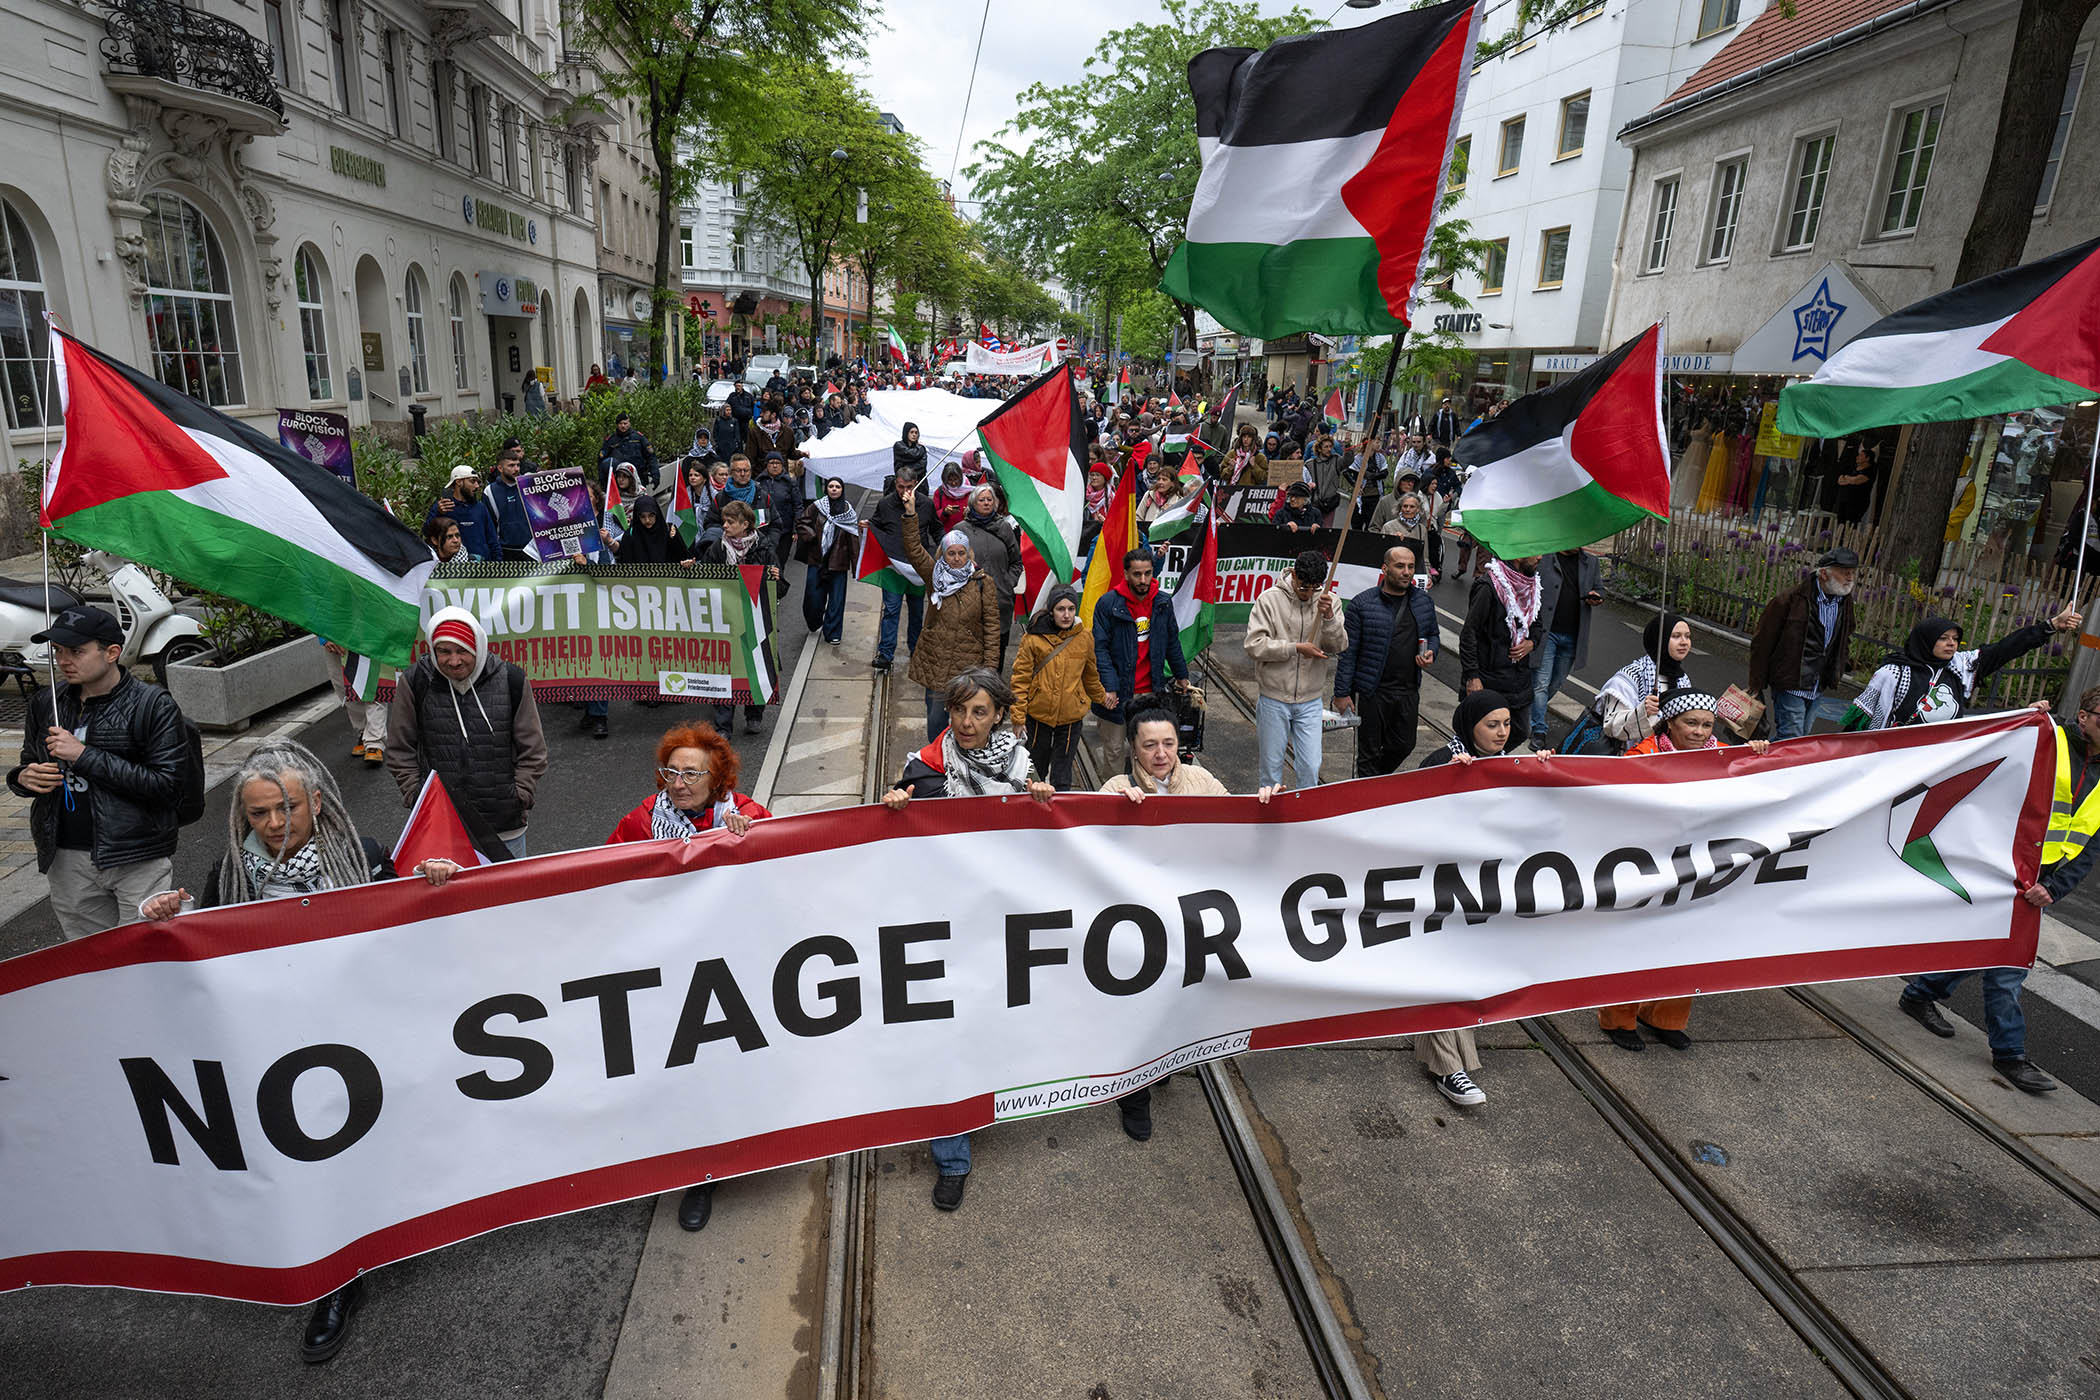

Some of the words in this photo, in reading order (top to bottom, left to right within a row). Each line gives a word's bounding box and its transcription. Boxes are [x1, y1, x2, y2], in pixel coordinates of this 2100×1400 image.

[330, 145, 386, 187] BIERGARTEN
[1434, 312, 1482, 333] STANYS
[1803, 307, 1831, 334] STERN
[1546, 358, 1579, 370] BRAUT
[1663, 355, 1713, 371] DMODE
[281, 418, 345, 437] EUROVISION
[295, 412, 329, 427] BLOCK
[522, 477, 583, 496] EUROVISION
[533, 471, 567, 486] BLOCK
[535, 527, 557, 538] DON'T
[557, 520, 596, 533] CELEBRATE
[549, 528, 585, 541] GENOCIDE
[1233, 558, 1265, 571] CAN'T
[420, 583, 586, 636] OYKOTT
[597, 583, 731, 634] ISRAEL
[489, 635, 593, 666] PARTHEID
[599, 635, 643, 664] UND
[649, 636, 731, 667] GENOZID
[119, 1043, 384, 1171] NO
[452, 920, 955, 1101] STAGE
[1005, 889, 1251, 1009] FOR
[1281, 828, 1834, 962] GENOCIDE
[995, 1033, 1250, 1113] www.palaestinasolidaritaet.at
